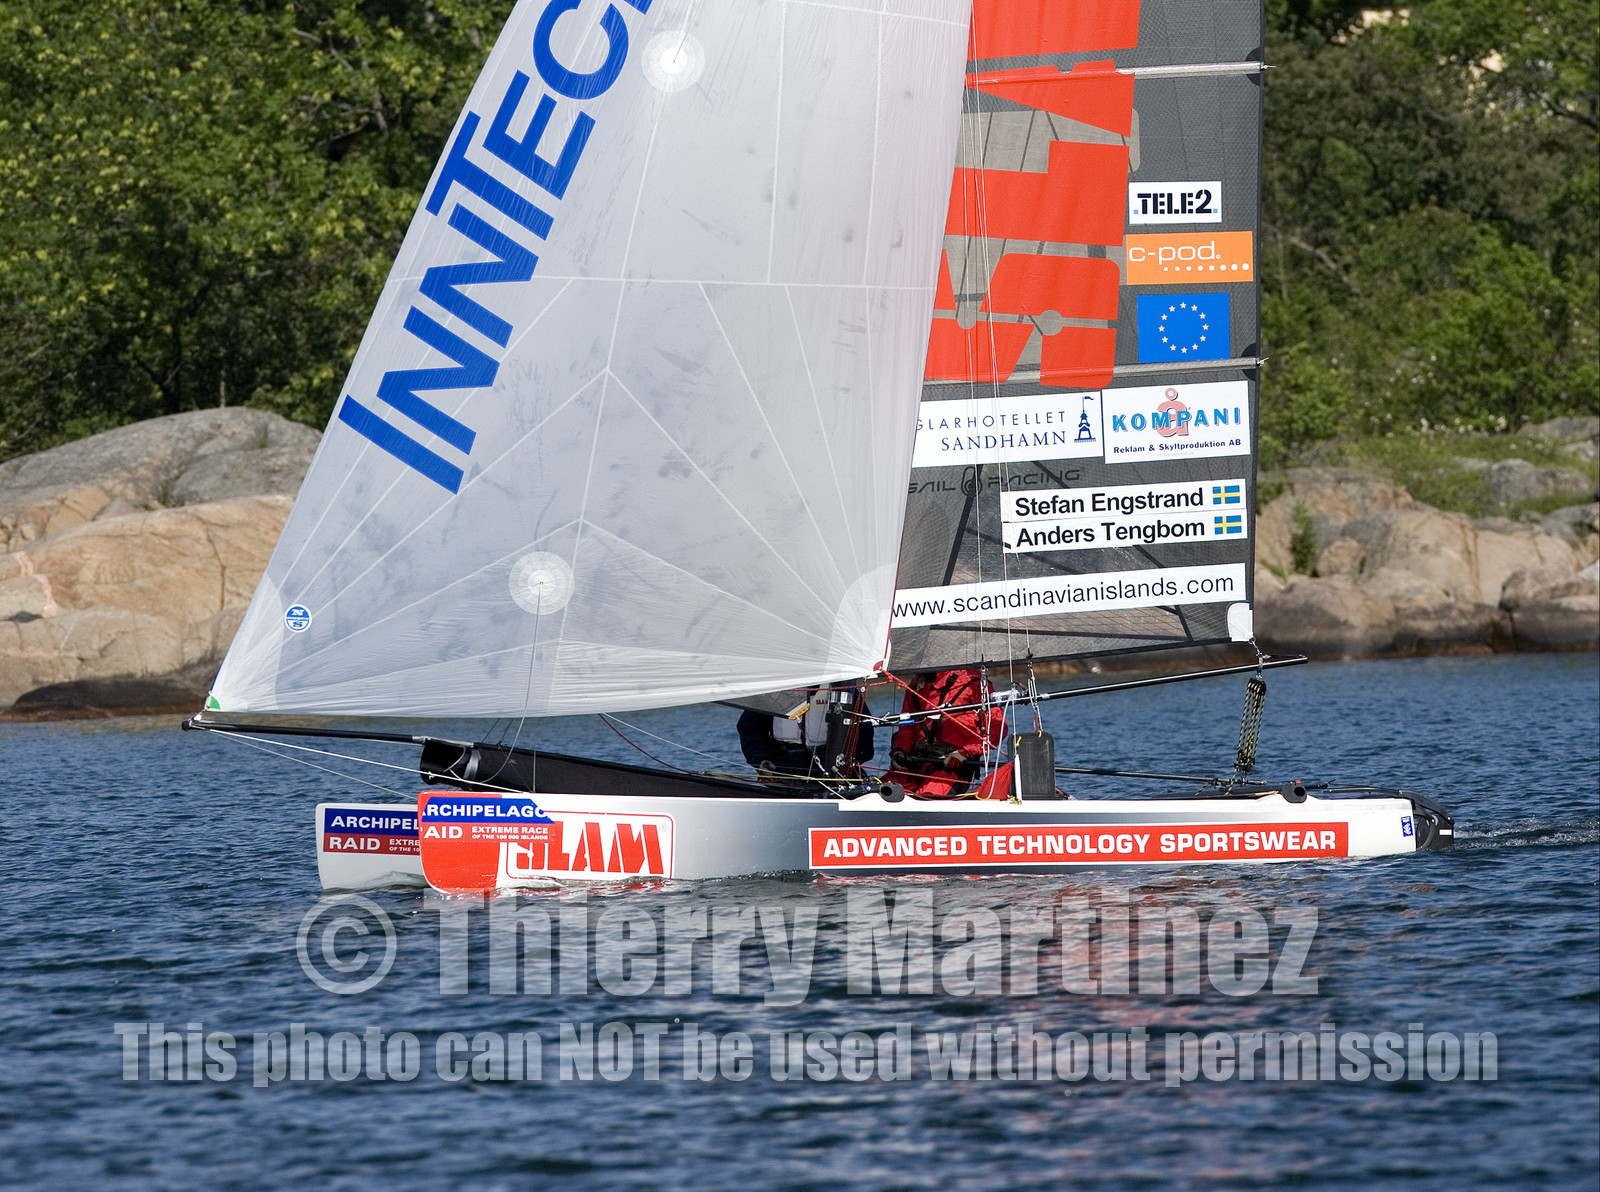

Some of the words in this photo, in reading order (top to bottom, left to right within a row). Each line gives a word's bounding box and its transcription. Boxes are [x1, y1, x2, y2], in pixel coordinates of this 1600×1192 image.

[1112, 407, 1242, 433] KOMPANI
[941, 431, 1067, 452] SANDHAMN
[1113, 445, 1145, 454] Reklam
[1149, 444, 1156, 452] &
[1158, 440, 1226, 452] Skyltproduktion
[1228, 438, 1242, 446] AB
[1015, 495, 1085, 517] Stefan
[1092, 487, 1204, 515] Engstrand
[1015, 525, 1096, 548] Anders
[1101, 519, 1206, 544] Tengbom
[892, 576, 1234, 618] www.scandinavianislands.com
[421, 825, 463, 839] AID
[471, 826, 519, 834] EXTREME
[521, 826, 549, 835] RACE
[329, 836, 381, 851] RAID
[823, 836, 968, 858] ADVANCED
[977, 833, 1151, 856] TECHNOLOGY
[1160, 830, 1336, 854] SPORTSWEAR
